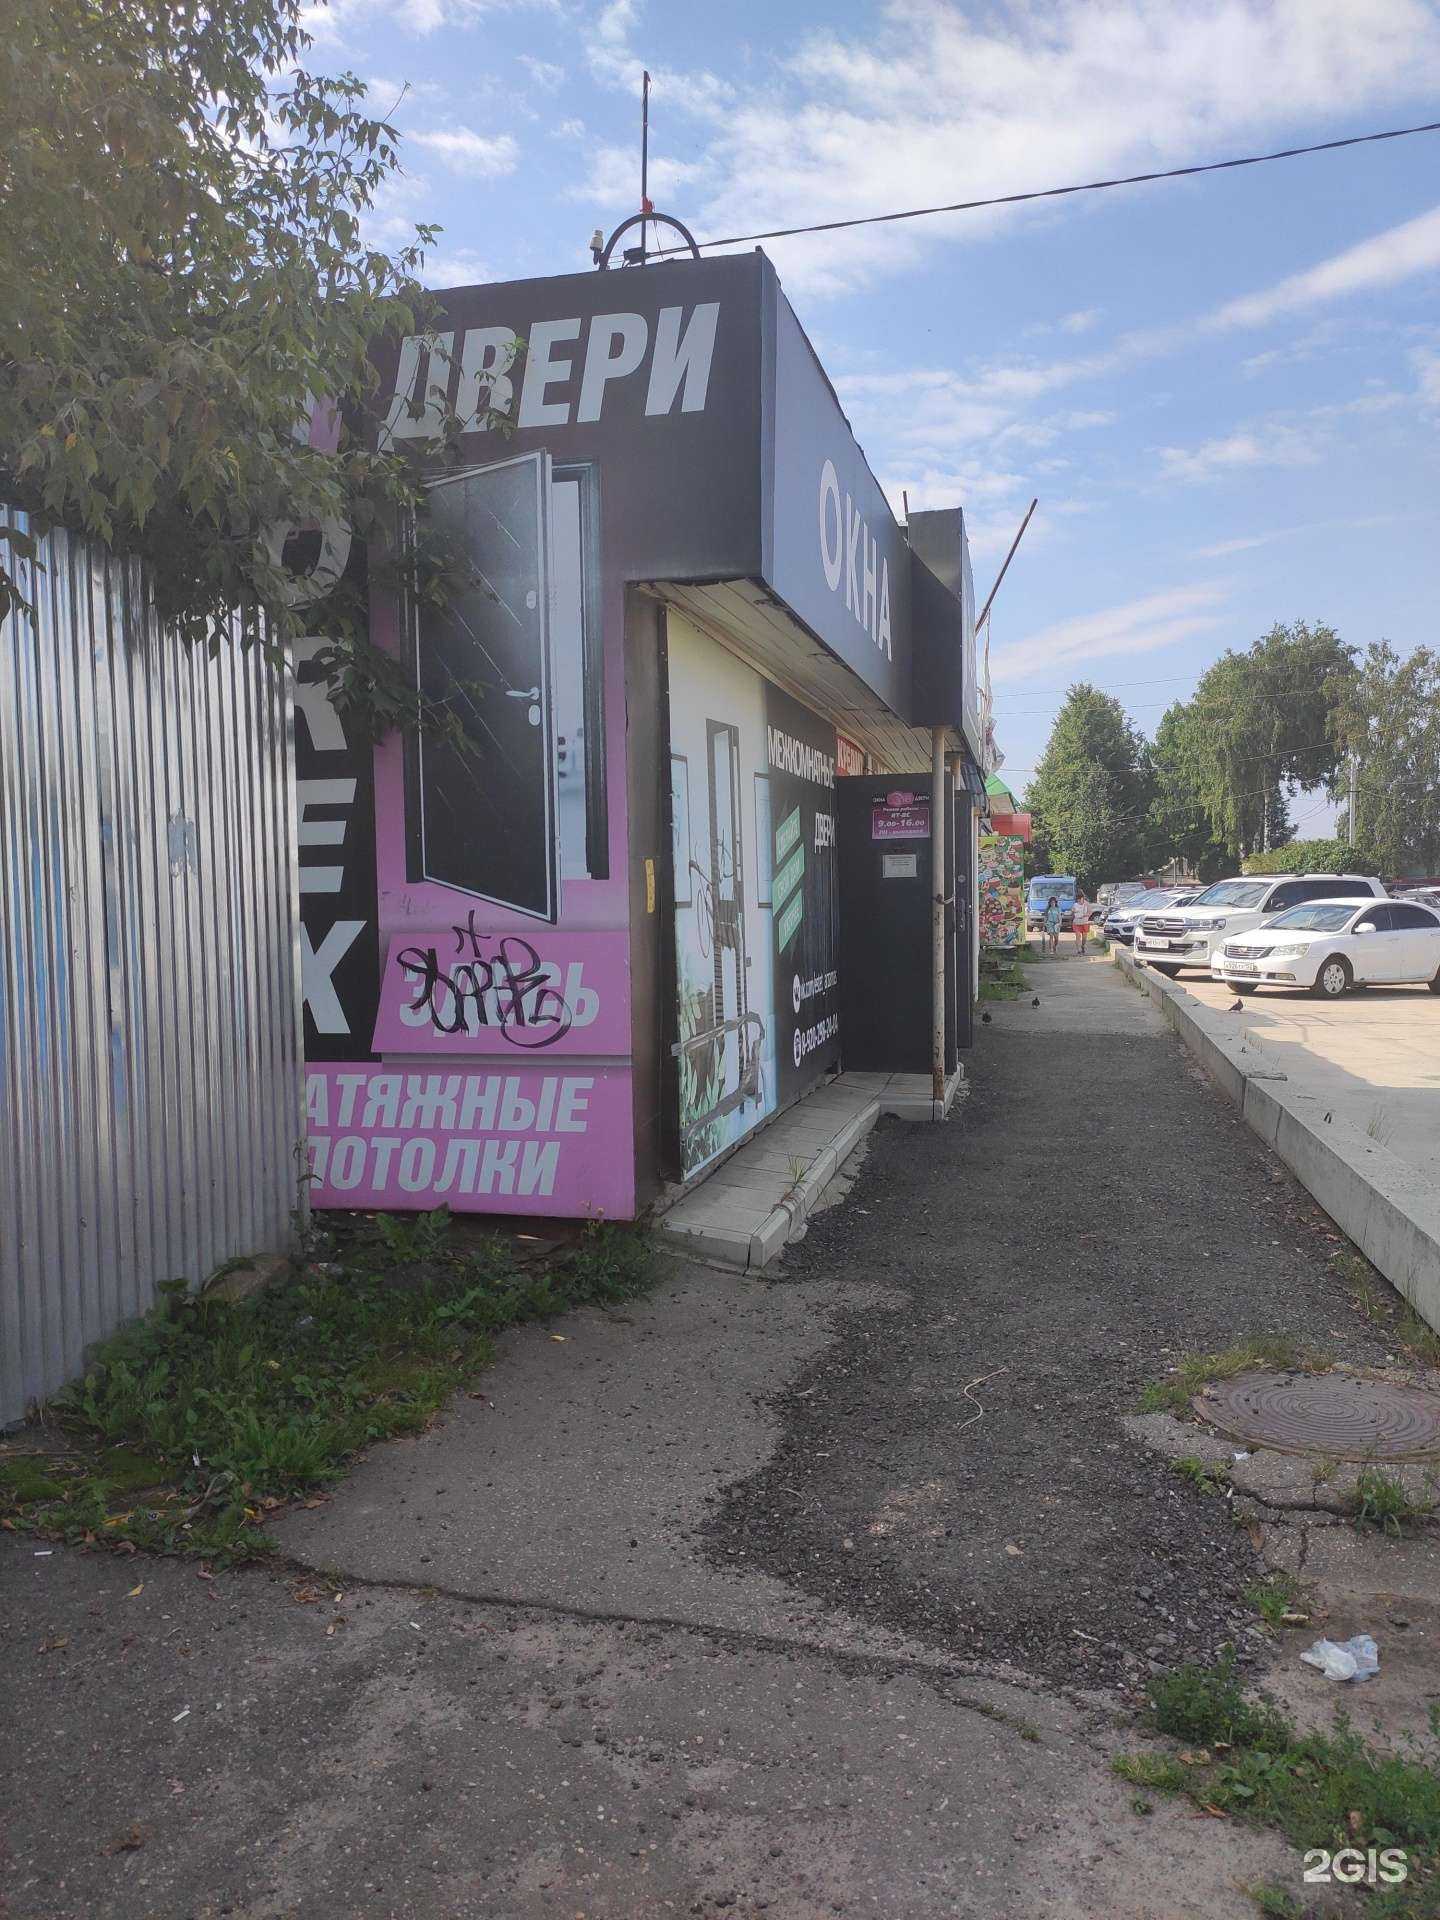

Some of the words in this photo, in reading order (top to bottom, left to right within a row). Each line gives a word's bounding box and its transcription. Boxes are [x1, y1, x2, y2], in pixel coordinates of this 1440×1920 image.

[377, 302, 720, 452] ДВЕРИ
[819, 458, 892, 663] ОКНА
[767, 725, 835, 789] МЕЖКОМНАТНЫЕ
[815, 812, 836, 854] ДВЕРИ
